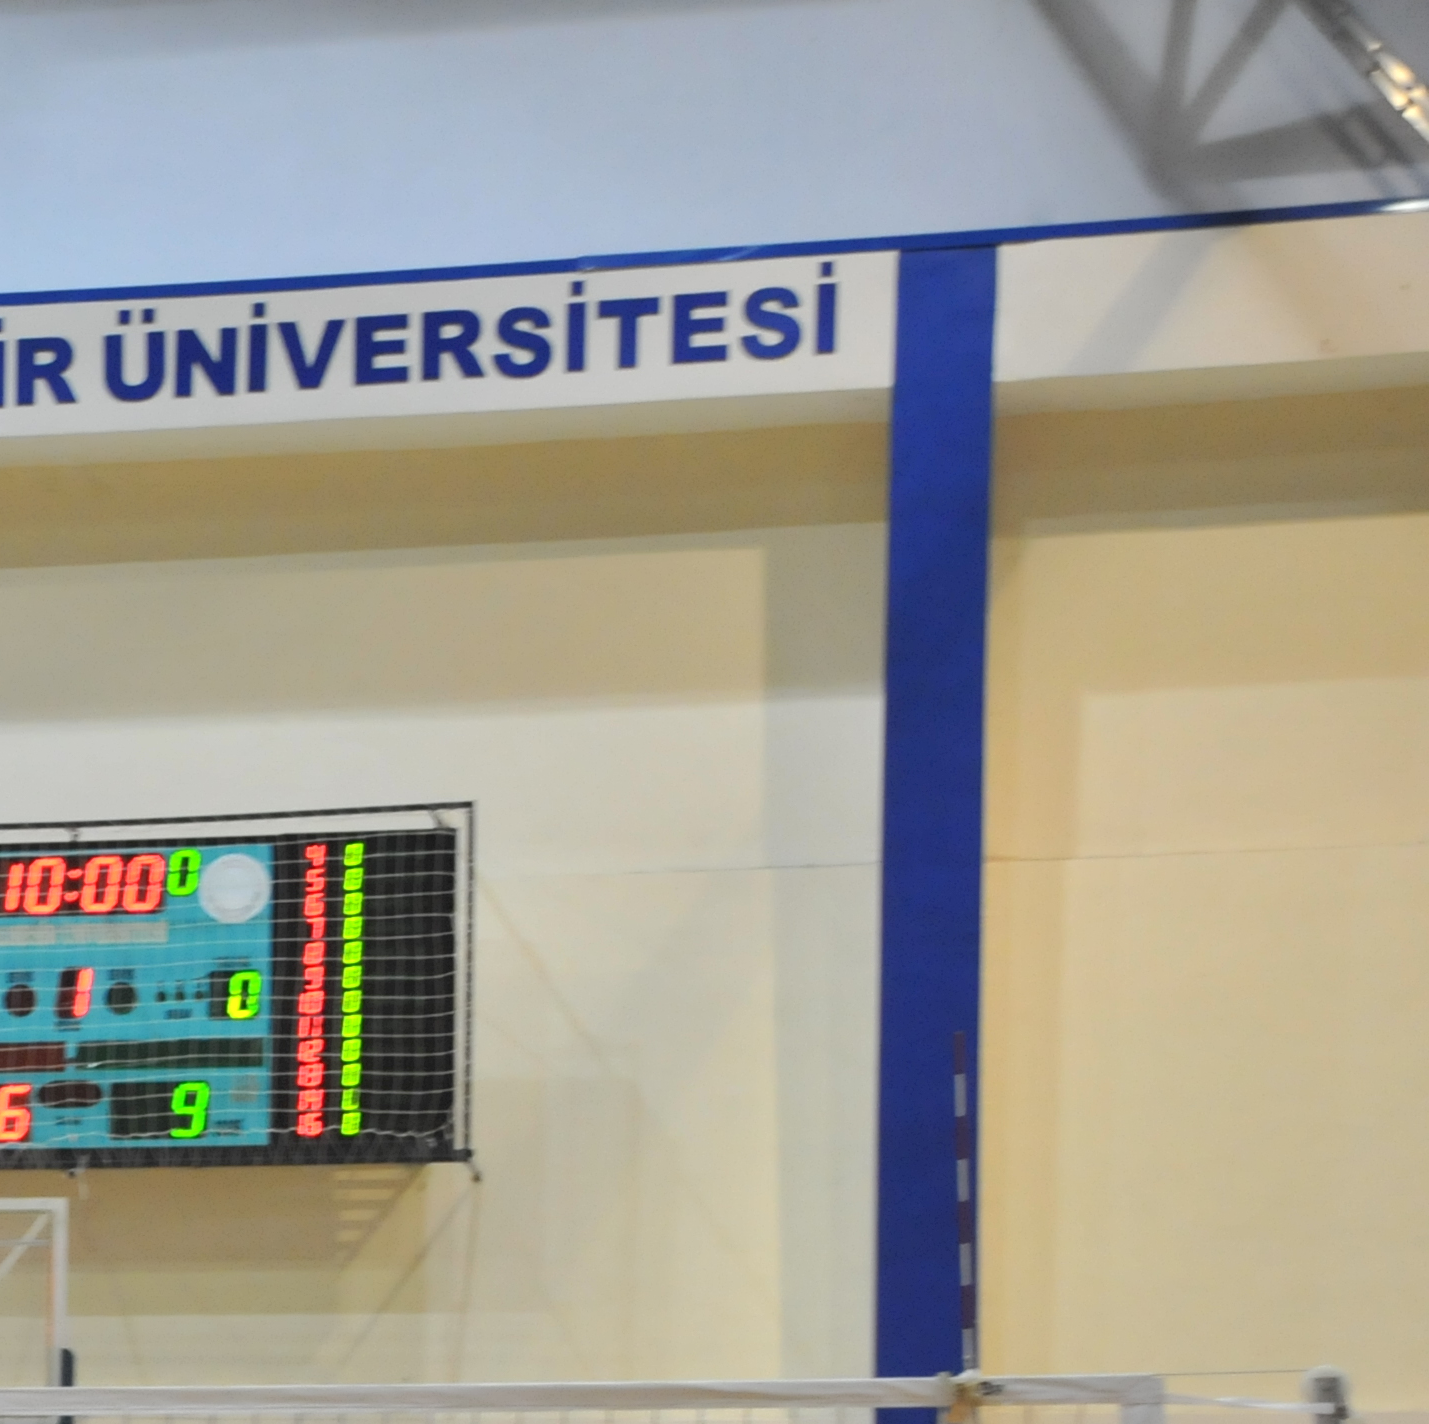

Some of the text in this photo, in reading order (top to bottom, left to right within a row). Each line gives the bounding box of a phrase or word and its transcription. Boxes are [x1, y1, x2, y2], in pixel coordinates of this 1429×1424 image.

[103, 261, 838, 402] ÜNİVERSİTESİ
[4, 852, 167, 916] 10:00
[166, 848, 202, 897] 0
[72, 966, 94, 1018] 1
[226, 970, 262, 1020] 0
[169, 1080, 211, 1139] 9
